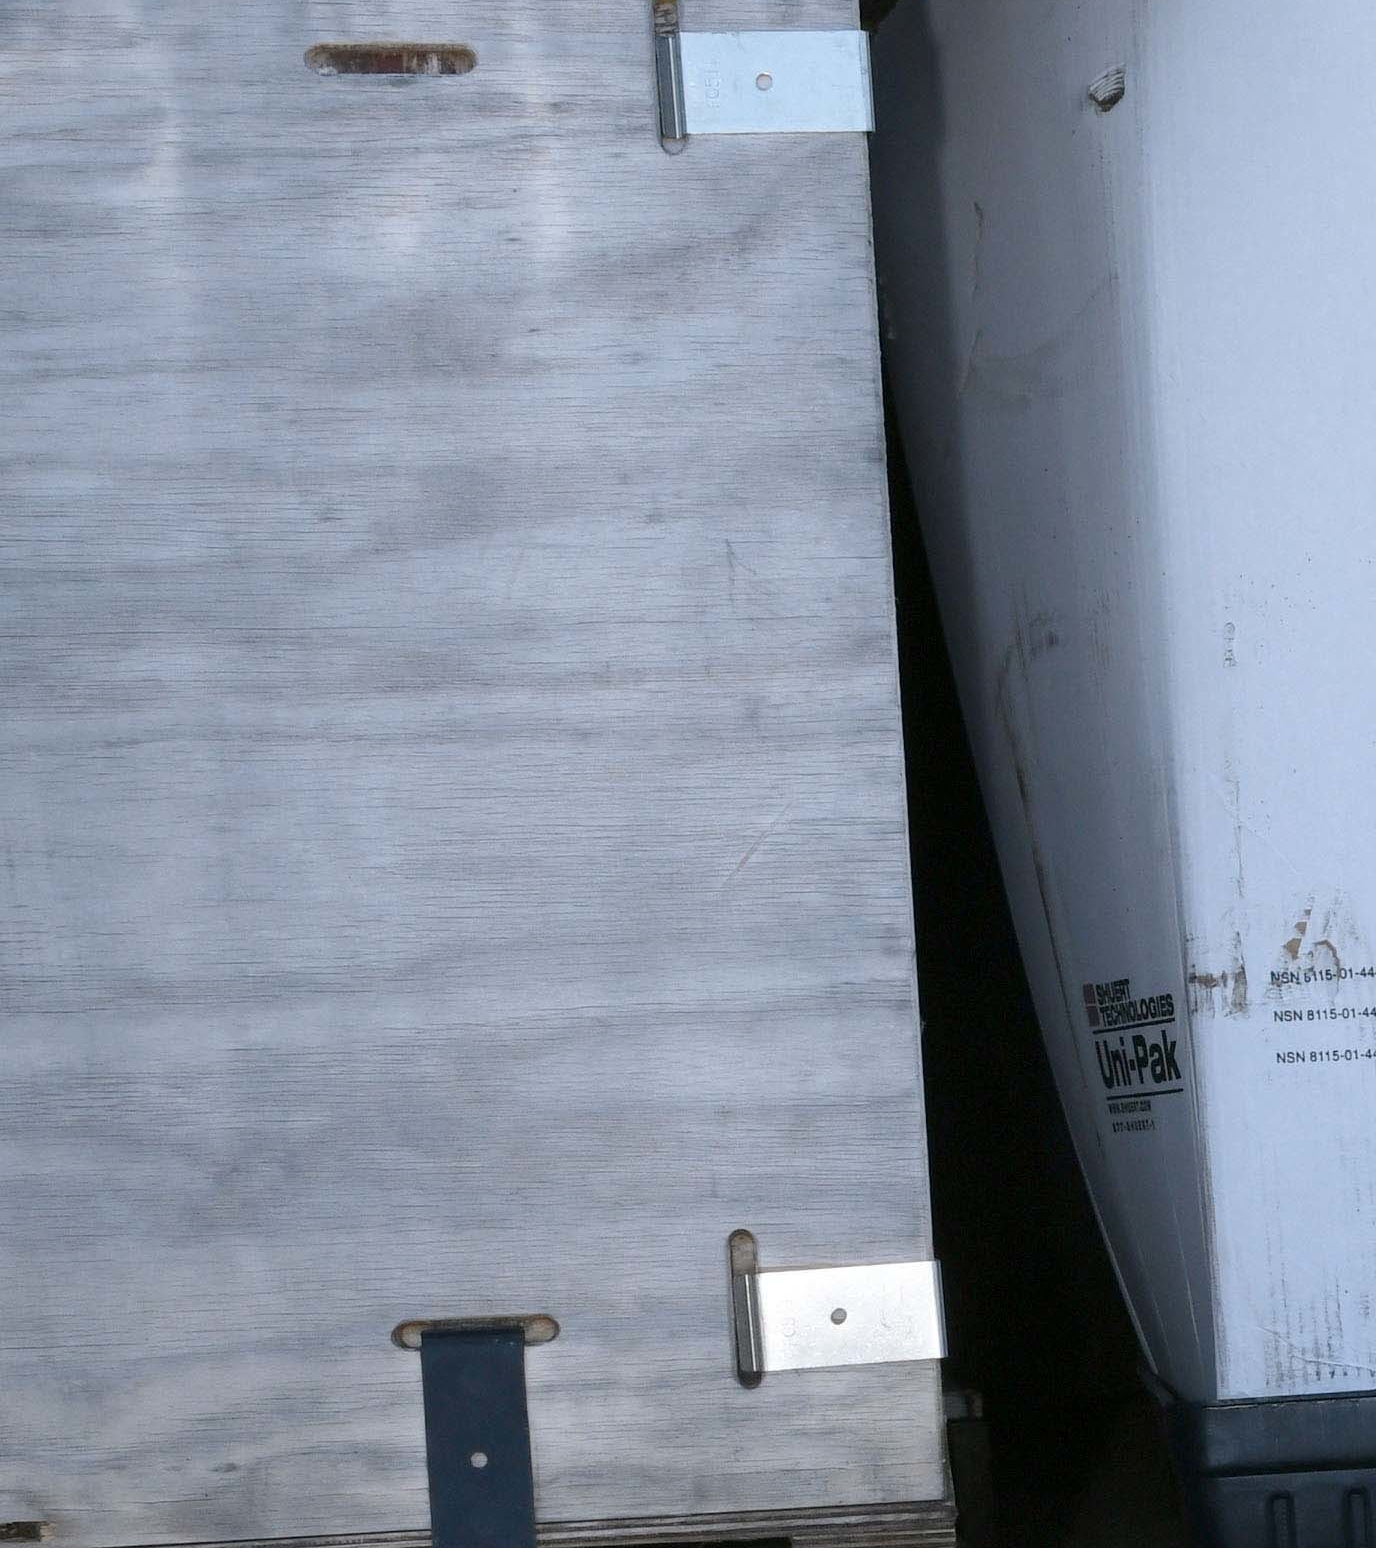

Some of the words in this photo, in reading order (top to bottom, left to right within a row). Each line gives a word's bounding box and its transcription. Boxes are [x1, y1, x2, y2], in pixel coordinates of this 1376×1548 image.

[1270, 970, 1300, 985] NSN
[1100, 993, 1176, 1028] TECHNOLOGIES
[1273, 1009, 1303, 1023] NSN
[1095, 1029, 1182, 1090] Uni-Pak
[1276, 1051, 1306, 1064] NSN
